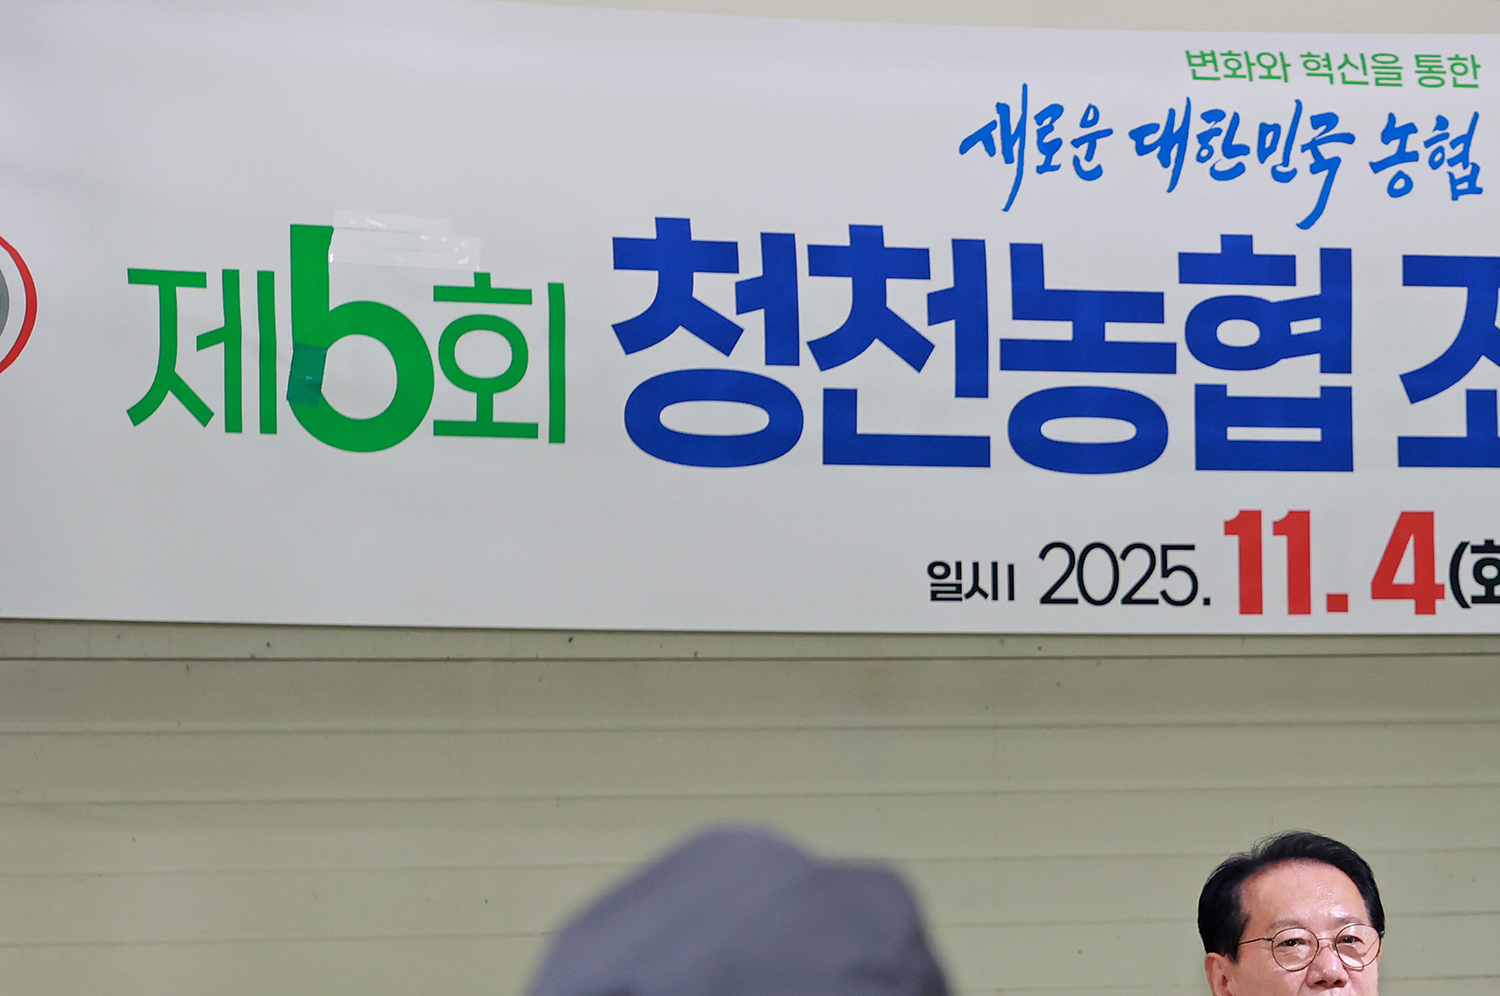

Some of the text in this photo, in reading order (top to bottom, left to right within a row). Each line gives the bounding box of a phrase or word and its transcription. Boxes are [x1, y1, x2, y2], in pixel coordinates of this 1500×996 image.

[1185, 50, 1481, 89] 변화와 혁신을 통한
[959, 83, 1483, 230] 새로운 대한민국 농협
[611, 216, 1354, 475] 청천농협
